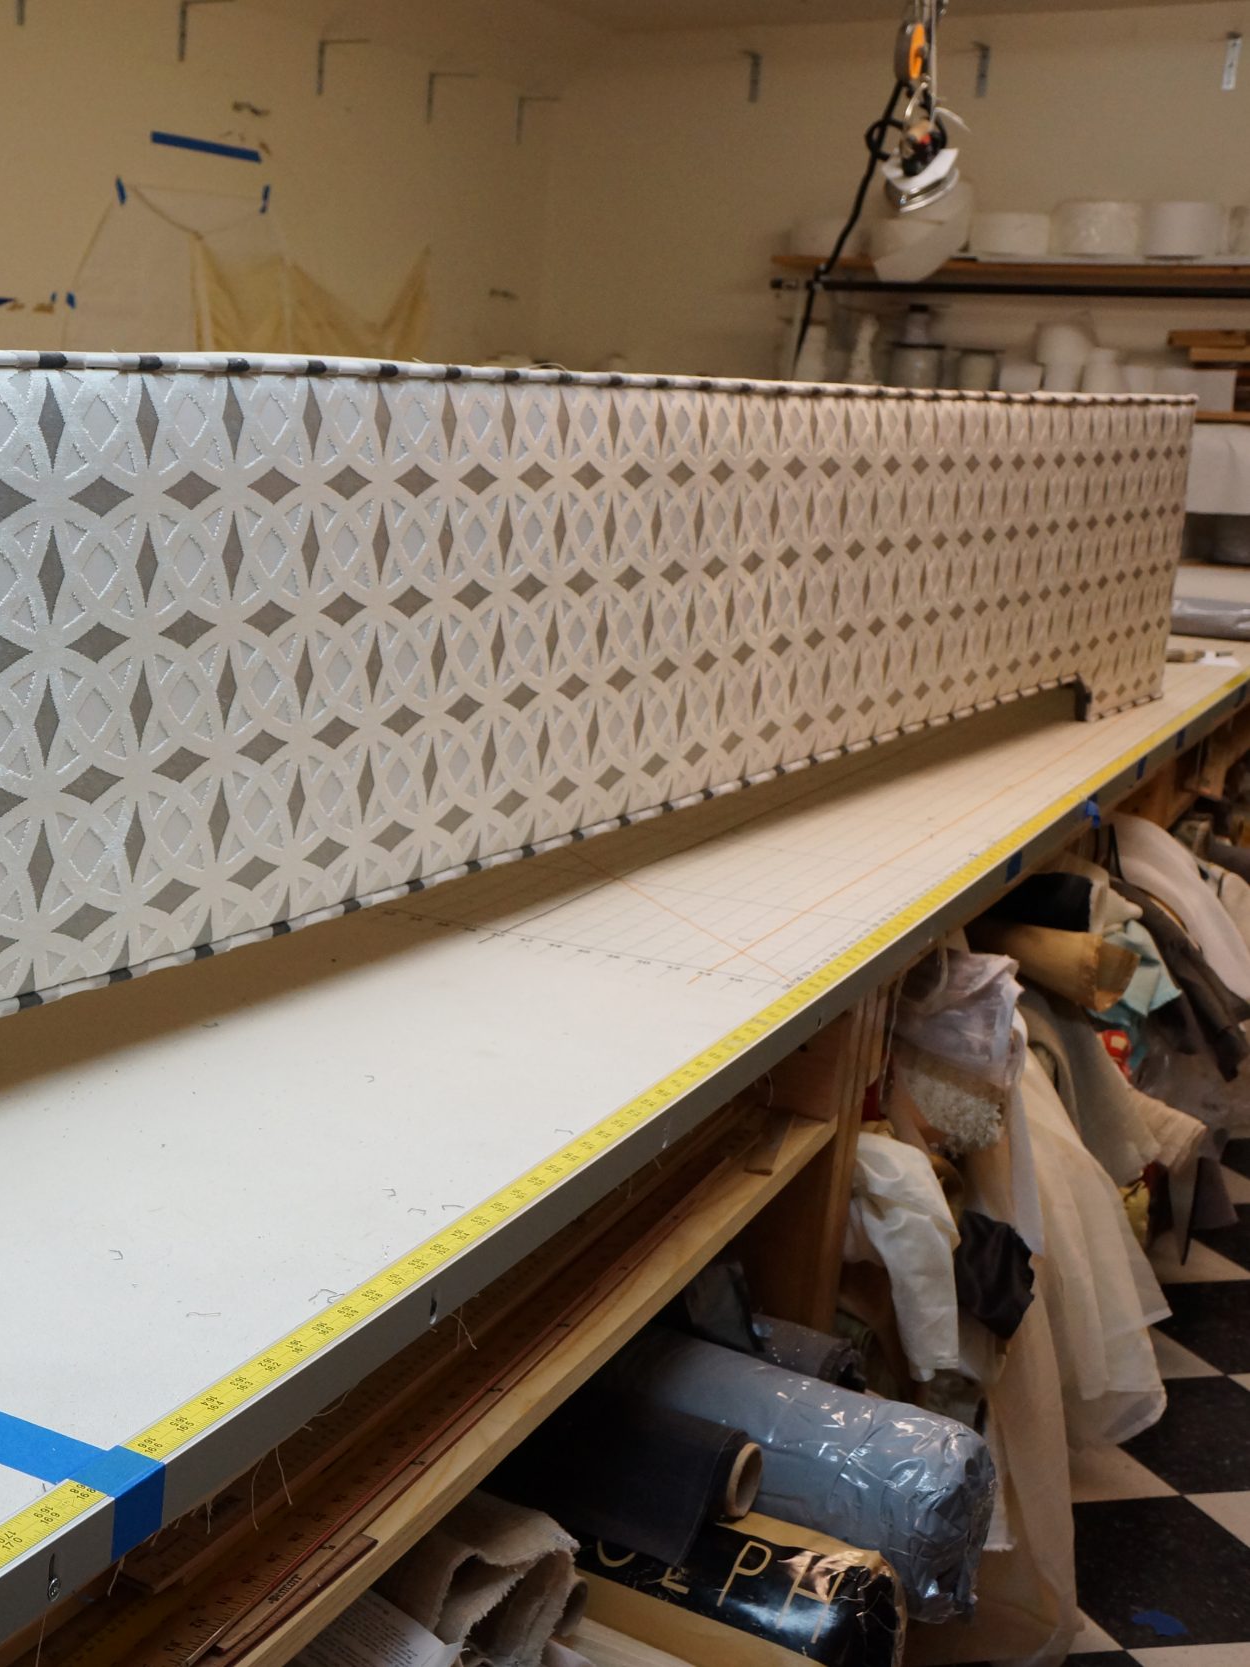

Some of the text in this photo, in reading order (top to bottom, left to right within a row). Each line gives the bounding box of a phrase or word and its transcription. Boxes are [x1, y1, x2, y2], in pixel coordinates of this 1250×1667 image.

[207, 1400, 224, 1411] 164
[176, 1421, 194, 1432] 165
[144, 1442, 163, 1454] 166
[40, 1512, 60, 1525] 169
[2, 1537, 23, 1550] 170
